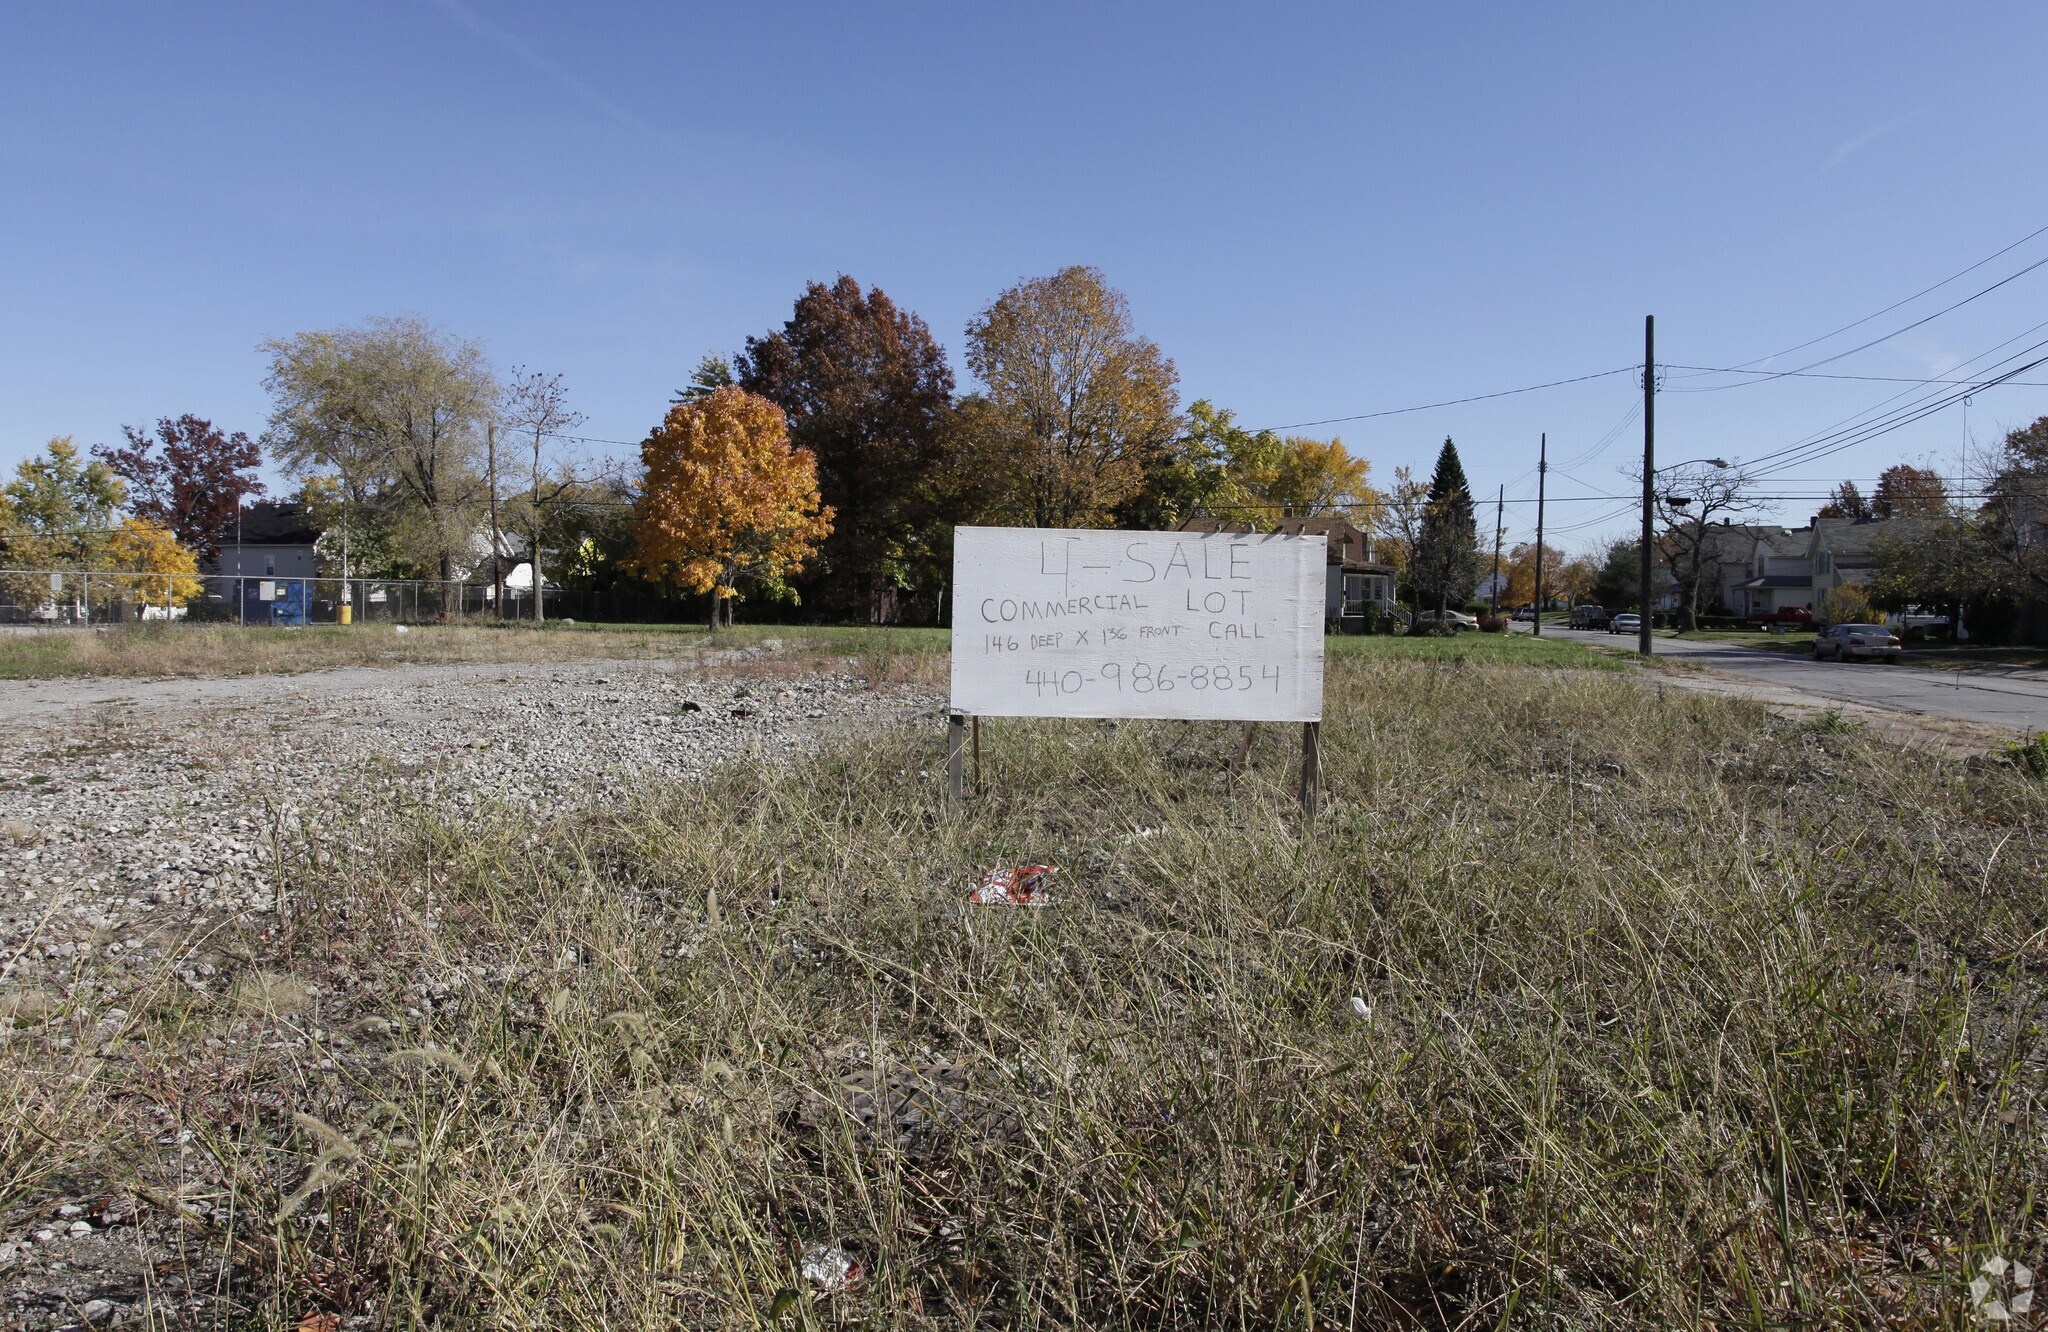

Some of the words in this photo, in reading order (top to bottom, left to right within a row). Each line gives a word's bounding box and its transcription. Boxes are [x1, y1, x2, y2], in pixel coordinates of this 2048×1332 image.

[981, 594, 1149, 624] COMMERCIAL
[1186, 588, 1252, 614] LOT
[984, 633, 1019, 654] 146
[1030, 631, 1064, 649] DEEP
[1139, 624, 1181, 639] FRONT
[1208, 621, 1266, 640] CALL
[1025, 662, 1281, 697] 440-986-8854
